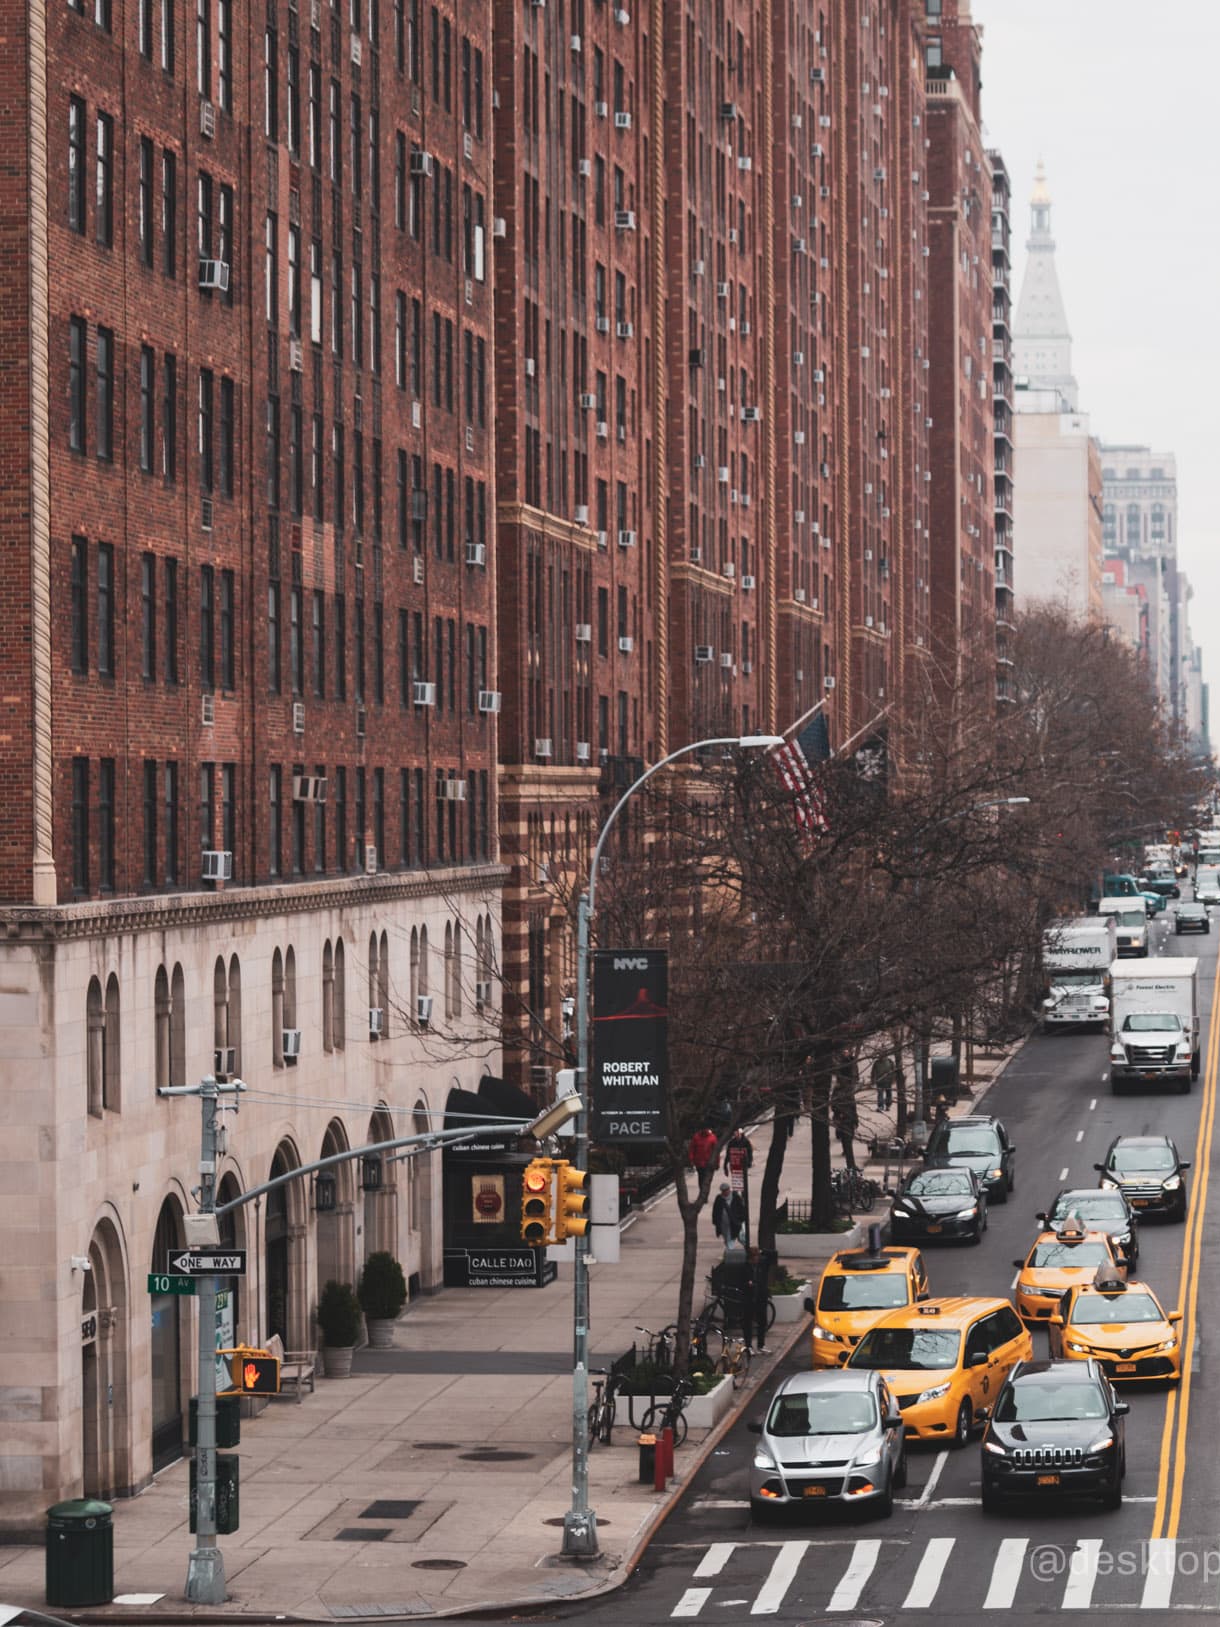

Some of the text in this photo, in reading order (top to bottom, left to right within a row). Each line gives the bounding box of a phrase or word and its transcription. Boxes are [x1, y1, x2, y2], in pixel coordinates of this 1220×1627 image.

[613, 957, 649, 971] NYC
[603, 1061, 651, 1073] ROBERT
[602, 1075, 659, 1086] WHITMAN
[609, 1121, 652, 1135] PACE
[180, 1258, 236, 1268] ONE WAY
[472, 1257, 532, 1268] CALLE DAO
[153, 1276, 170, 1292] 10
[469, 1276, 489, 1285] cuban
[489, 1275, 514, 1285] chinese
[514, 1275, 536, 1285] cuisine
